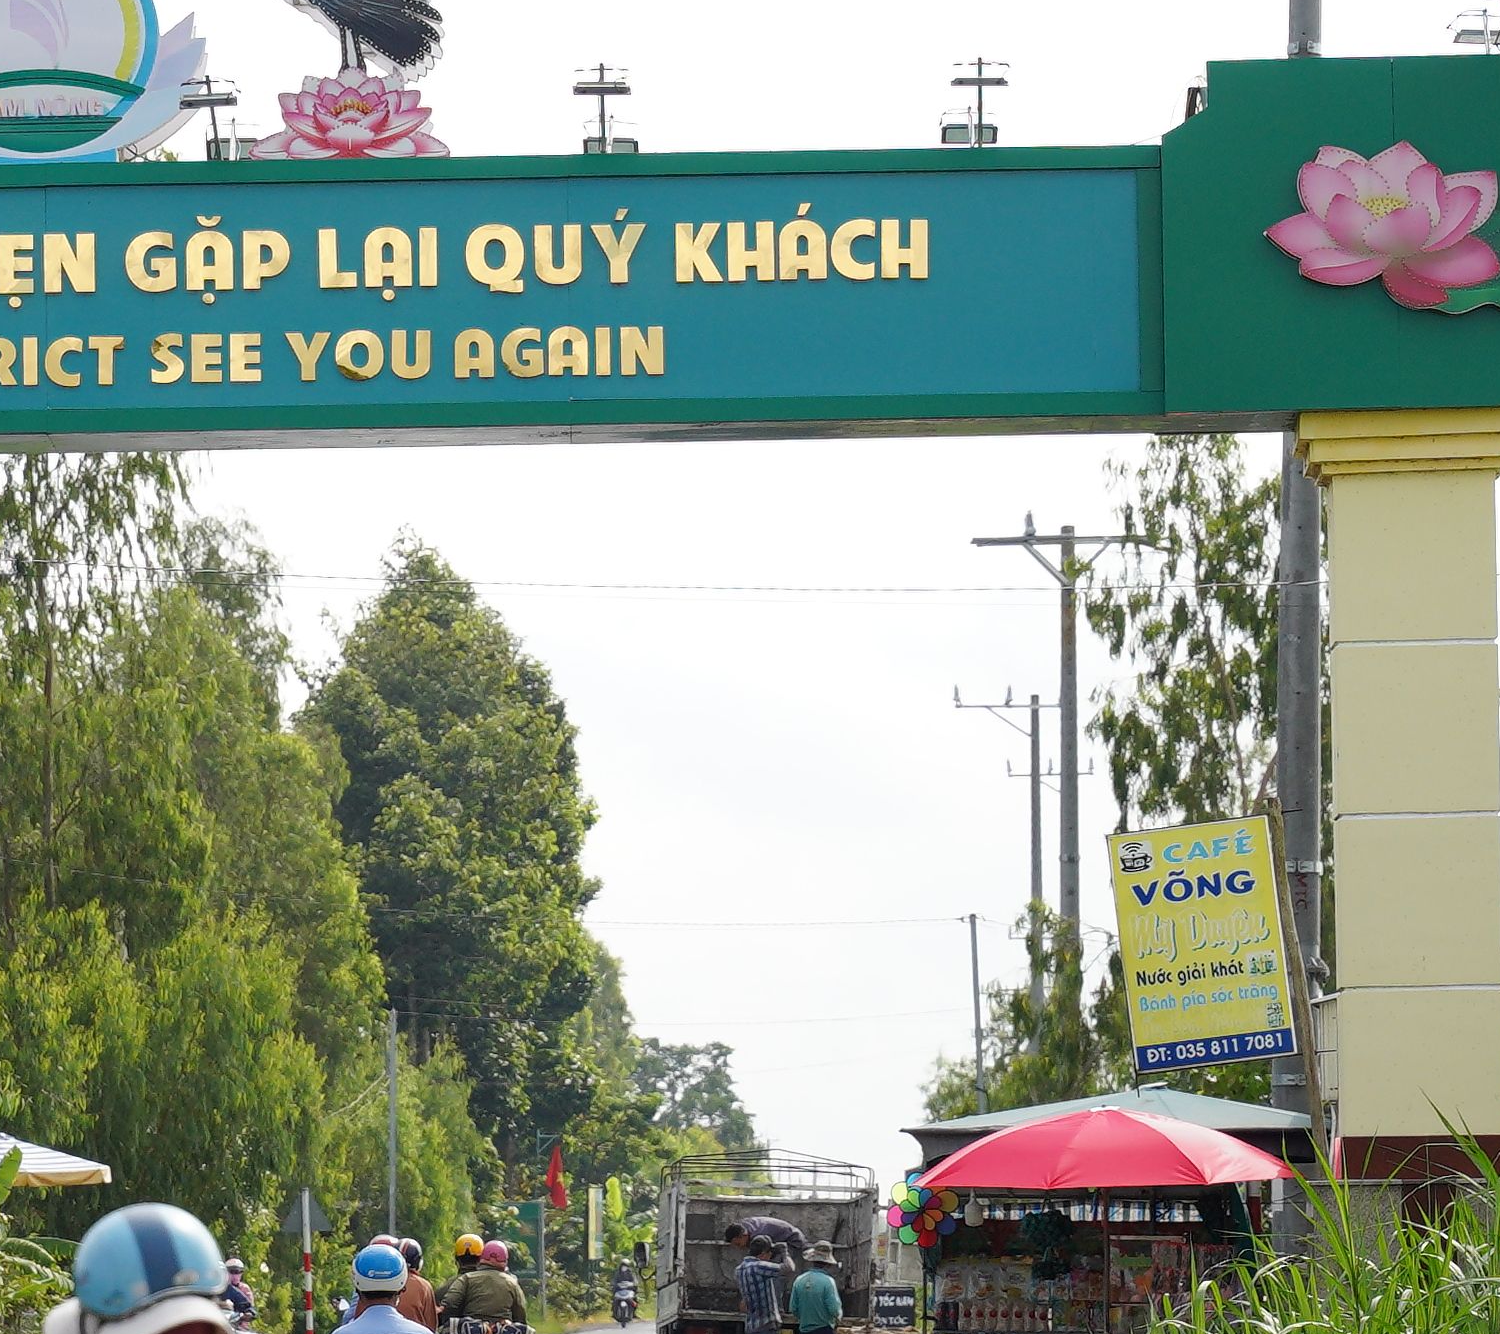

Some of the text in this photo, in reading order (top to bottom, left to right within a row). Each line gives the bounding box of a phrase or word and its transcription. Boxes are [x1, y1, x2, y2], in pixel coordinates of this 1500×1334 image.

[34, 95, 105, 116] NÔNG
[124, 215, 291, 304] GẶP
[317, 226, 438, 301] LẠI
[464, 208, 645, 293] QUÝ
[674, 202, 929, 283] KHÁCH
[151, 332, 262, 384] SEE
[285, 329, 432, 381] YOU
[454, 325, 665, 379] AGAIN
[1162, 829, 1255, 863] CAFÉ
[1131, 869, 1256, 907] VÕNG
[1136, 959, 1244, 987] Nước giải khát
[1139, 994, 1177, 1012] Bánh
[1182, 989, 1206, 1010] pía
[1147, 1033, 1283, 1063] ĐT: 035 811 7081
